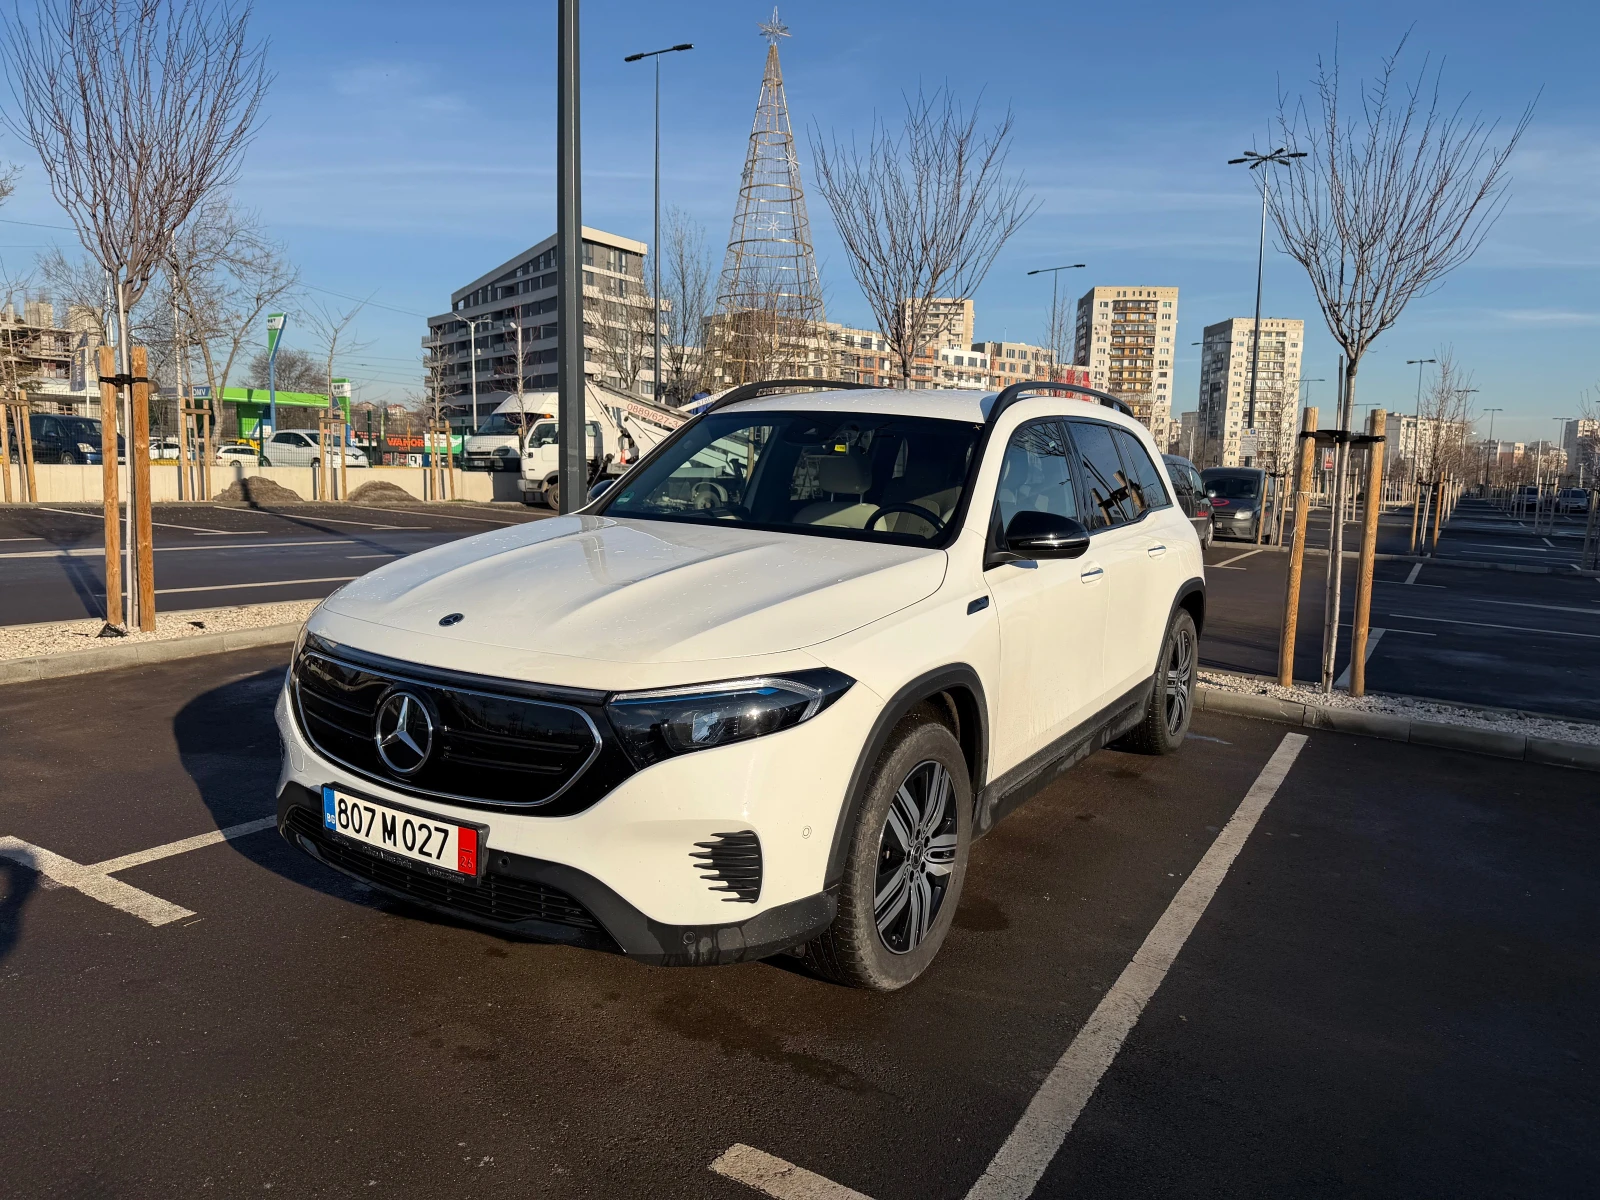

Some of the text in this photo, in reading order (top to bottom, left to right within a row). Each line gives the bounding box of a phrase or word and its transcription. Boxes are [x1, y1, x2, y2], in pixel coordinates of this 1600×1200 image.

[193, 388, 206, 396] OMV
[627, 403, 682, 428] 0889/627-3
[326, 813, 335, 824] BG
[338, 798, 376, 837] 807
[382, 811, 397, 847] M
[402, 818, 449, 860] 027
[460, 856, 474, 869] 26
